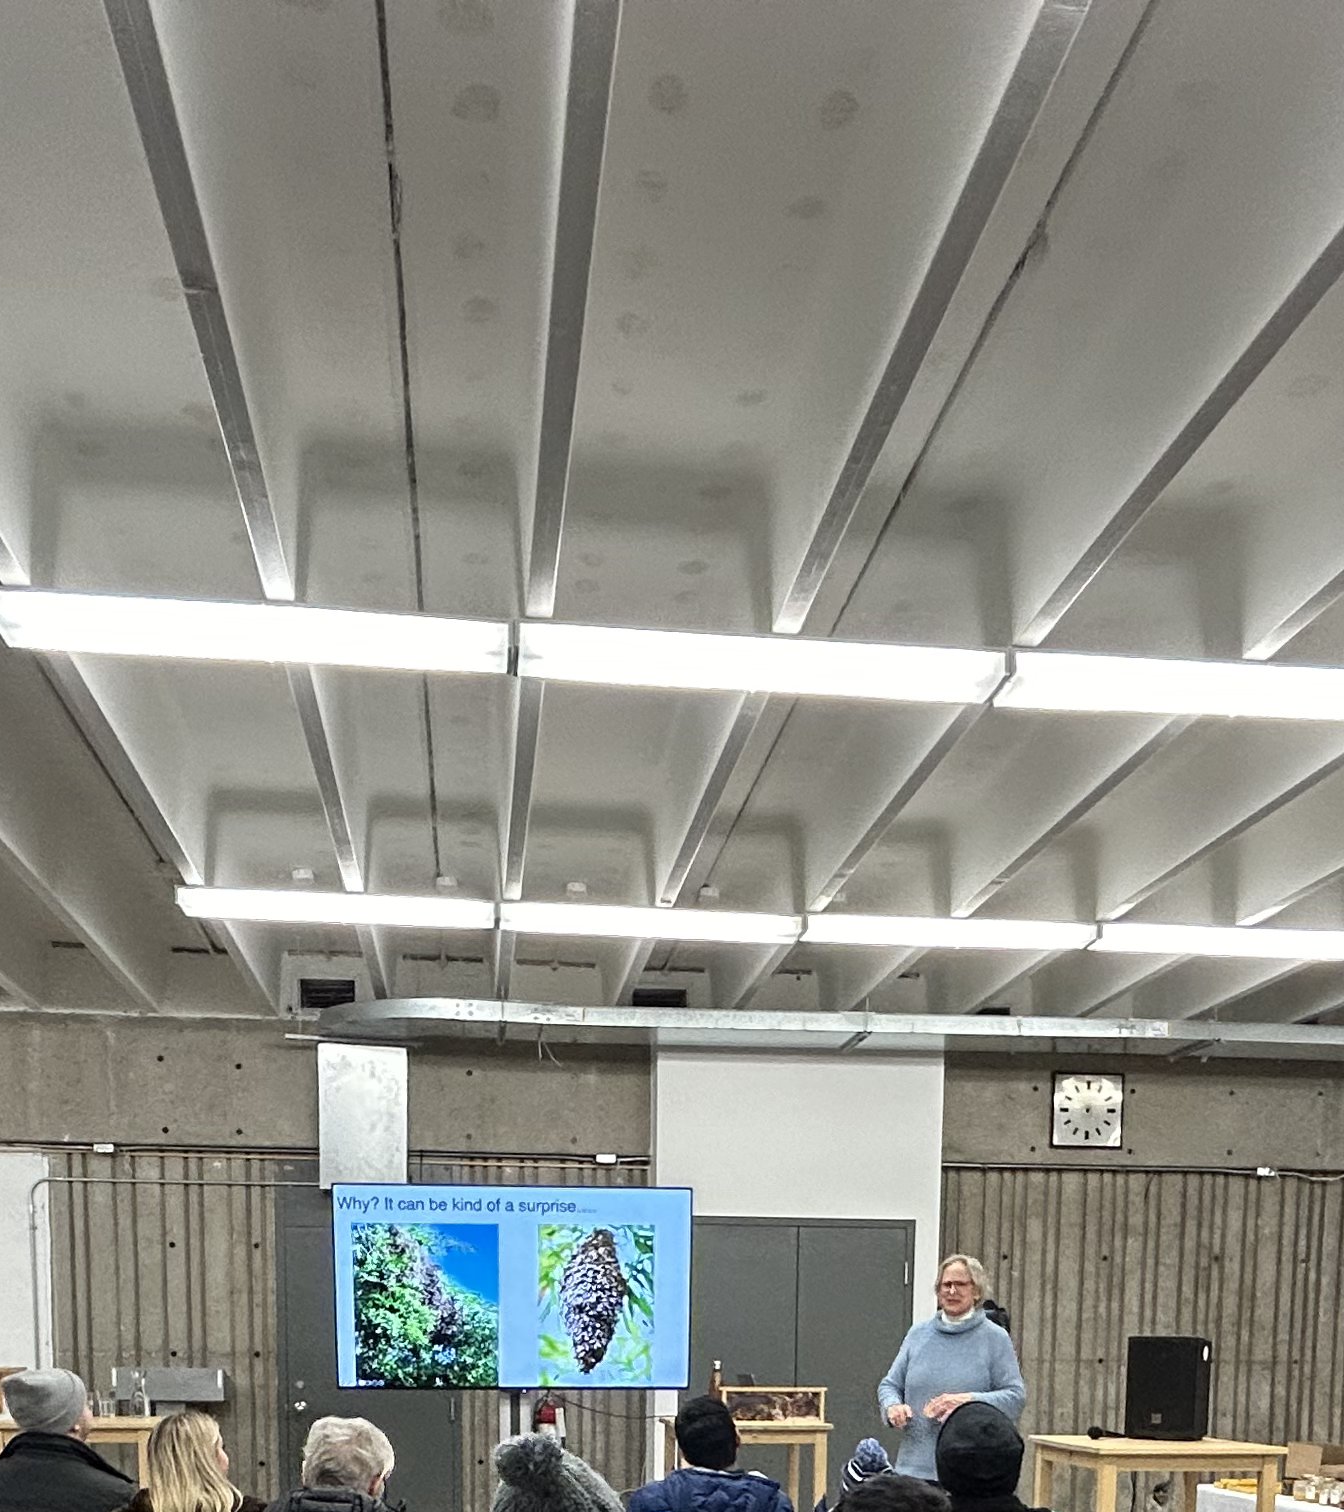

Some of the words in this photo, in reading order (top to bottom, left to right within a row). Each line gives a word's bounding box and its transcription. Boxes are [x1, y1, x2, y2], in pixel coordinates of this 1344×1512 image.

[336, 1196, 380, 1214] Why?
[384, 1197, 394, 1211] It
[397, 1199, 425, 1212] can
[429, 1198, 448, 1212] be
[452, 1198, 483, 1212] kind
[486, 1198, 501, 1213] of
[504, 1201, 514, 1213] a
